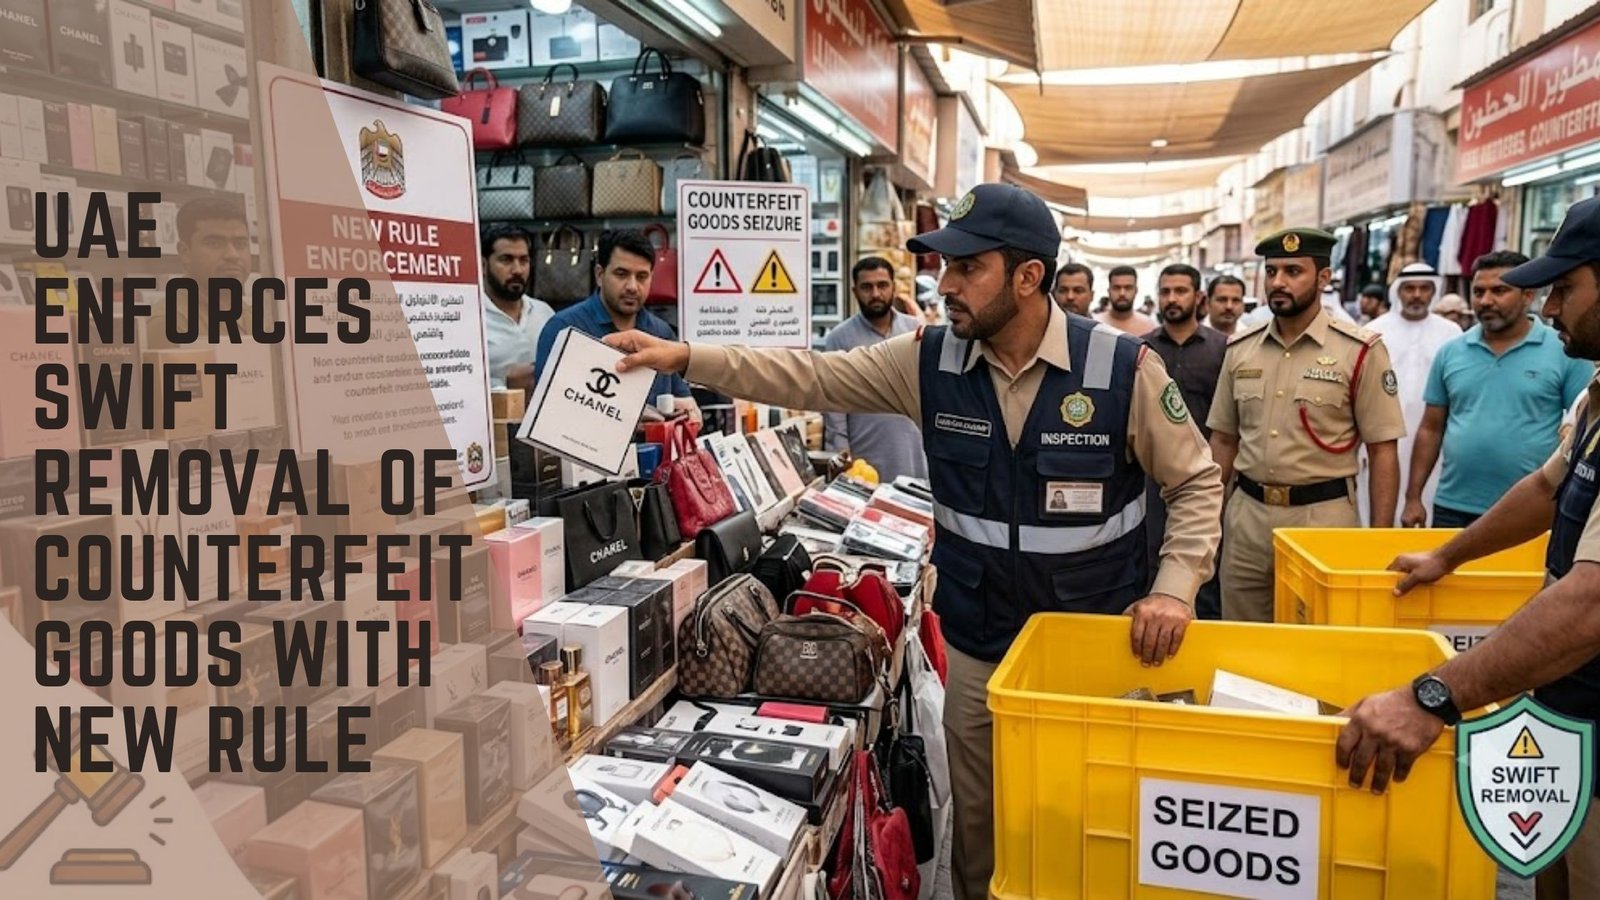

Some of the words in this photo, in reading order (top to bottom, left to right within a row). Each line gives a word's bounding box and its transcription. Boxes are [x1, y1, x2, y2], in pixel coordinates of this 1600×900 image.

[0, 7, 39, 28] HANEL
[59, 25, 102, 46] CHANEL
[688, 191, 802, 210] COUNTERFEIT
[332, 214, 382, 242] NEW
[388, 220, 439, 247] RULE
[688, 213, 740, 230] GOODS
[743, 215, 802, 231] SEIZURE
[306, 244, 462, 277] ENFORCEMENT
[10, 351, 62, 362] CHANEL
[564, 387, 623, 422] CHANEL
[1041, 432, 1110, 446] INSPECTION
[1153, 795, 1300, 839] SEIZED
[1151, 840, 1301, 886] GOODS
